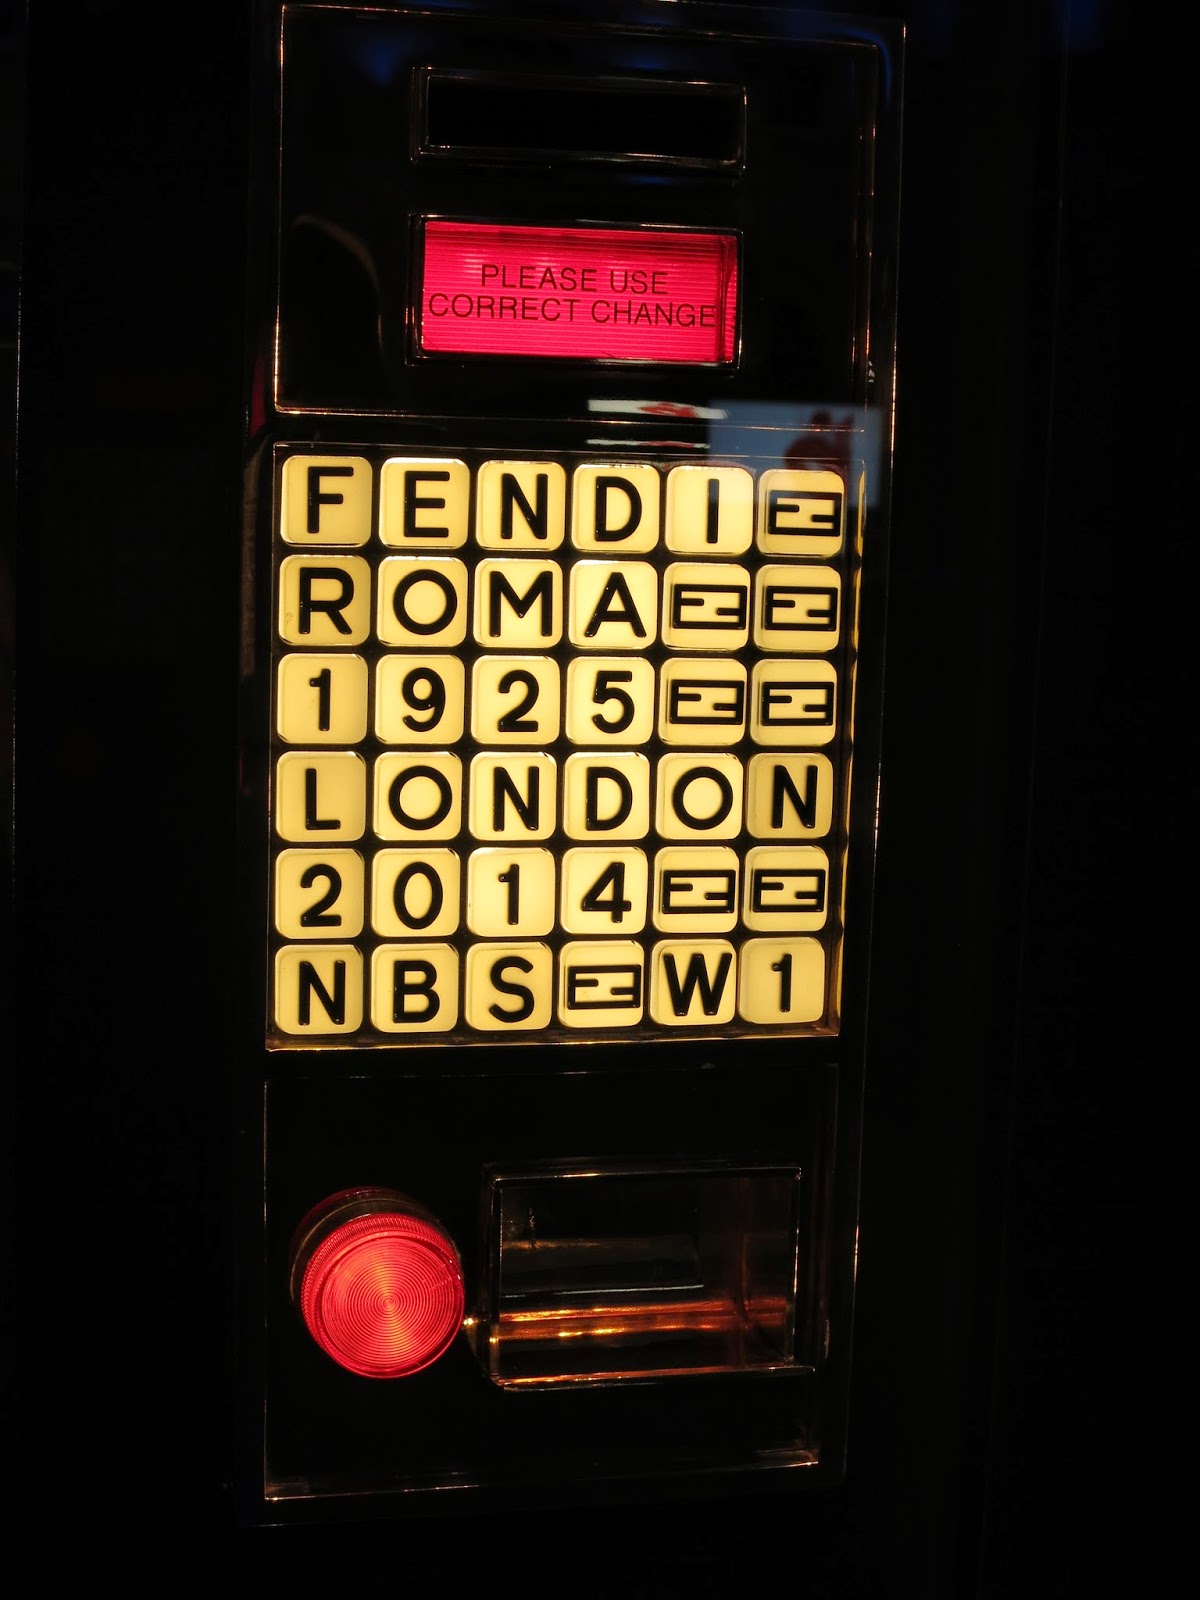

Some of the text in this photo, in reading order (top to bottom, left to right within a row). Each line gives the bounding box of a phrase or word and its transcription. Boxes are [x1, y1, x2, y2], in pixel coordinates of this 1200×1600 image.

[429, 293, 717, 328] CORRECT CHANGE
[481, 264, 668, 295] PLEASE USE
[307, 466, 721, 545] FENDI
[300, 567, 647, 638] ROMA
[305, 765, 818, 832] LONDON
[299, 955, 536, 1025] NBS
[663, 952, 793, 1016] W1
